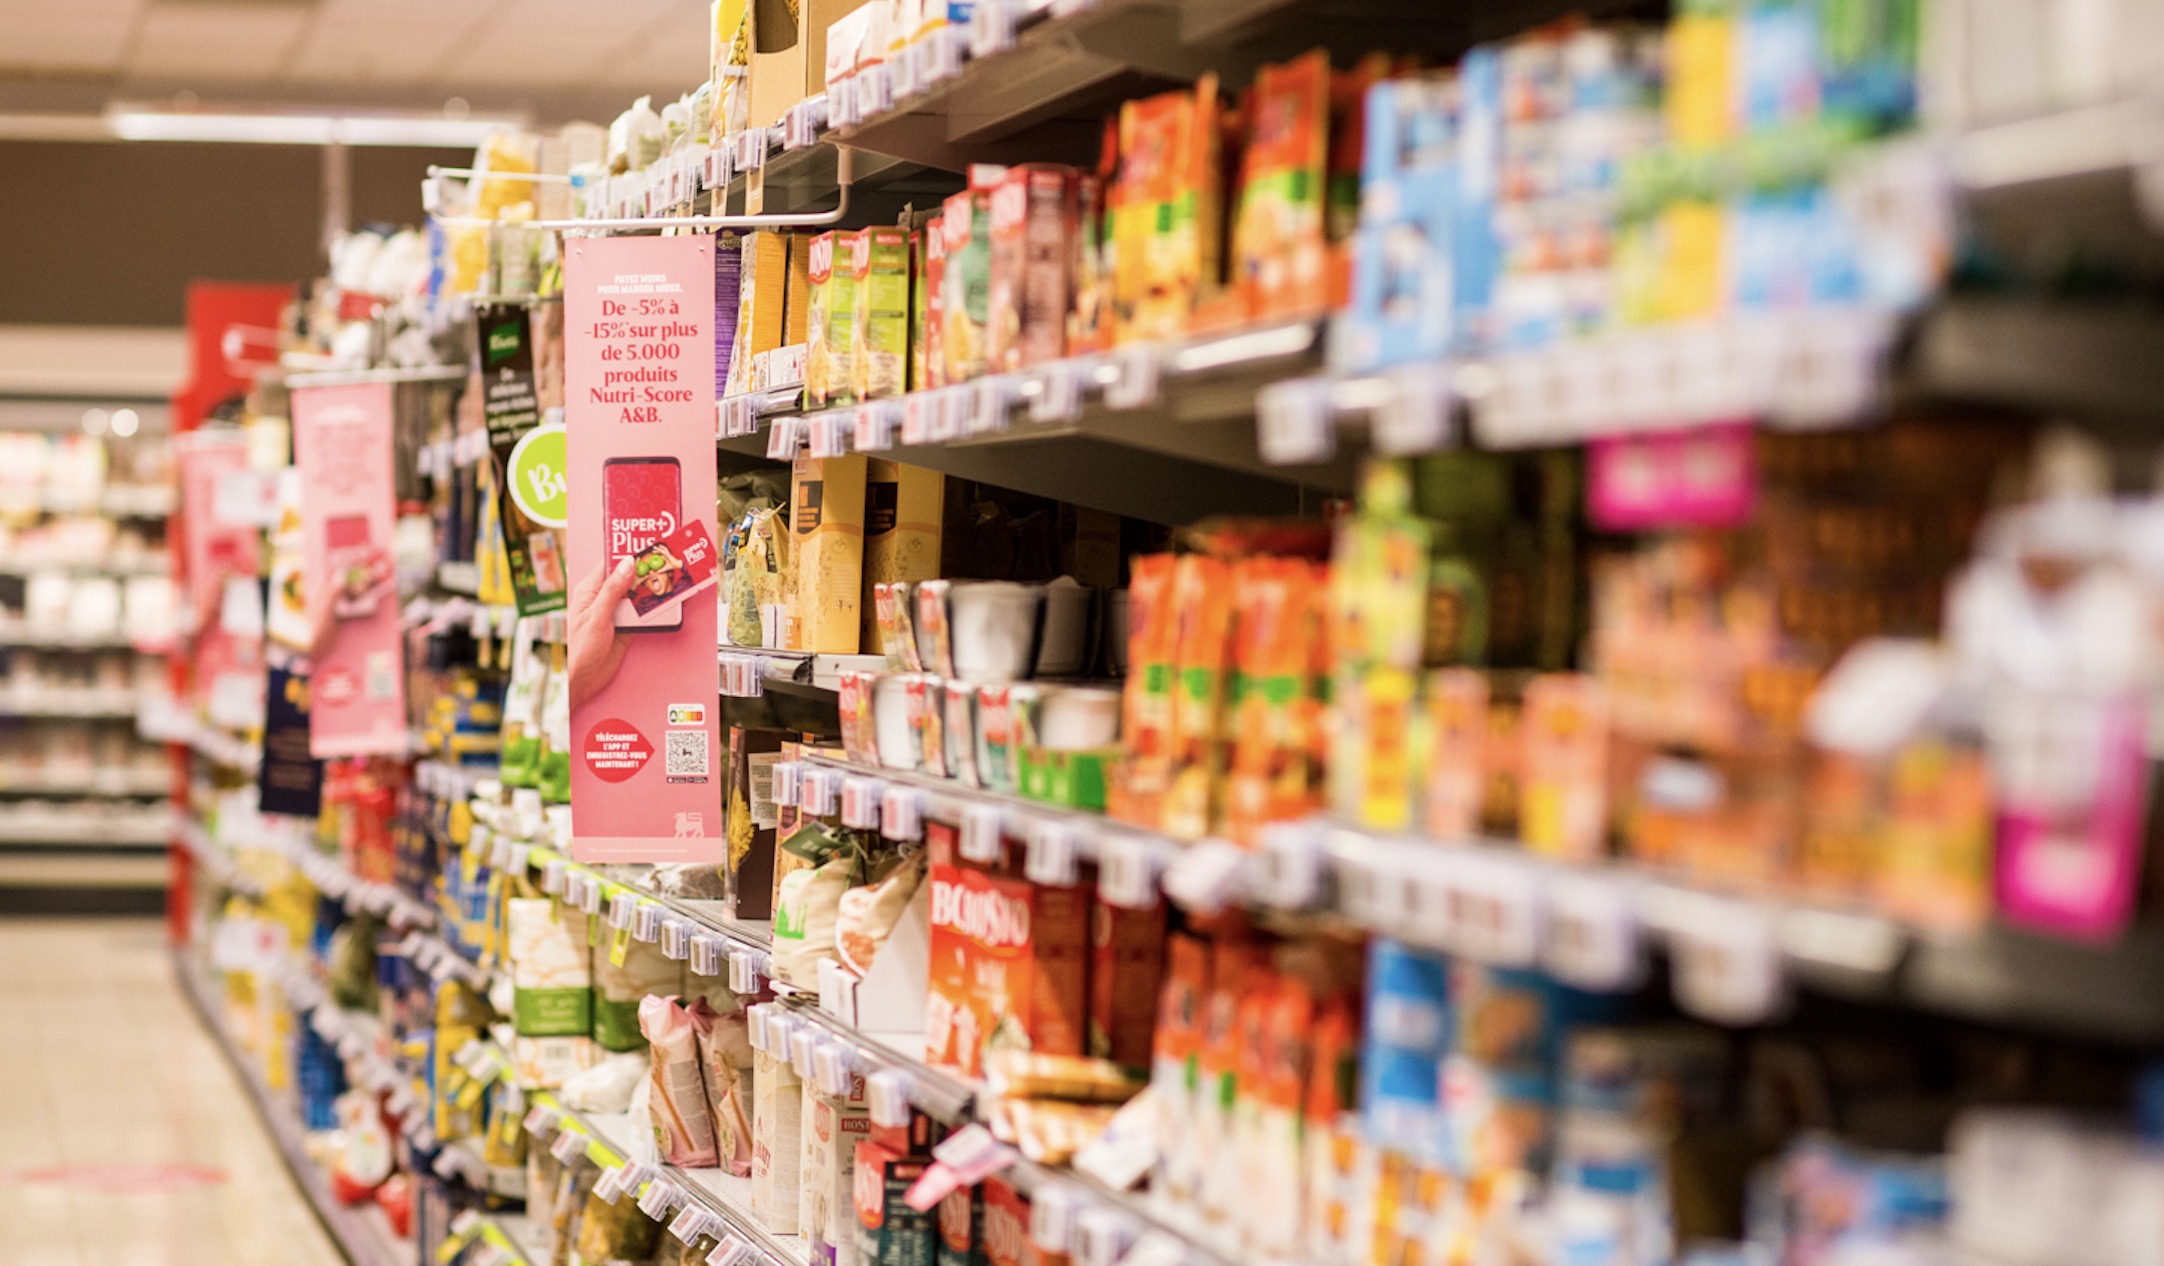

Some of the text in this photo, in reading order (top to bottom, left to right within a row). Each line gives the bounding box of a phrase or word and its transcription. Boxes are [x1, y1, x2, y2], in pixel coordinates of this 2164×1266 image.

[614, 274, 639, 284] PAYEZ
[597, 285, 619, 294] POUR
[621, 284, 654, 294] MANGER
[602, 299, 679, 316] De -5% à
[629, 323, 657, 338] sur
[661, 322, 698, 341] plus
[601, 343, 680, 361] de 5.000
[604, 367, 678, 387] produits
[590, 387, 693, 404] Nutri-Score
[619, 407, 662, 423] A&B.
